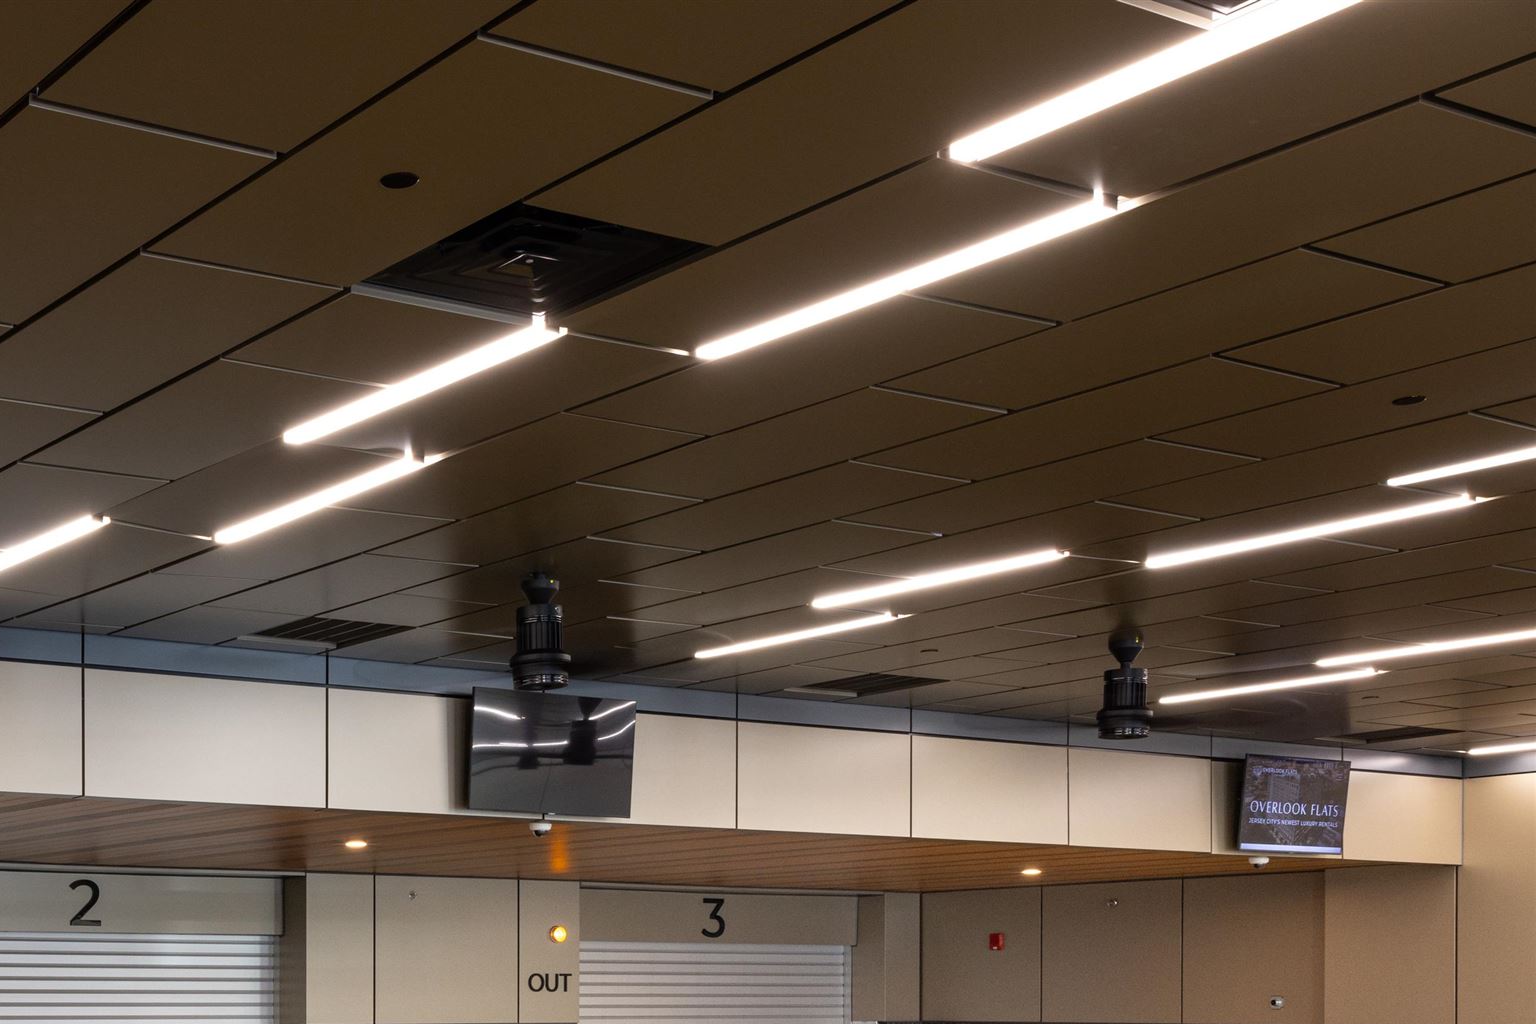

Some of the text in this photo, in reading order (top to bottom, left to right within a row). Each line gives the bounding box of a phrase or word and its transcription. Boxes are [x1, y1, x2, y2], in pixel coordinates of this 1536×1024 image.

[1250, 800, 1339, 818] OVERLOOK FLATS
[68, 879, 101, 926] 2
[701, 898, 725, 938] 3
[527, 972, 573, 993] OUT
